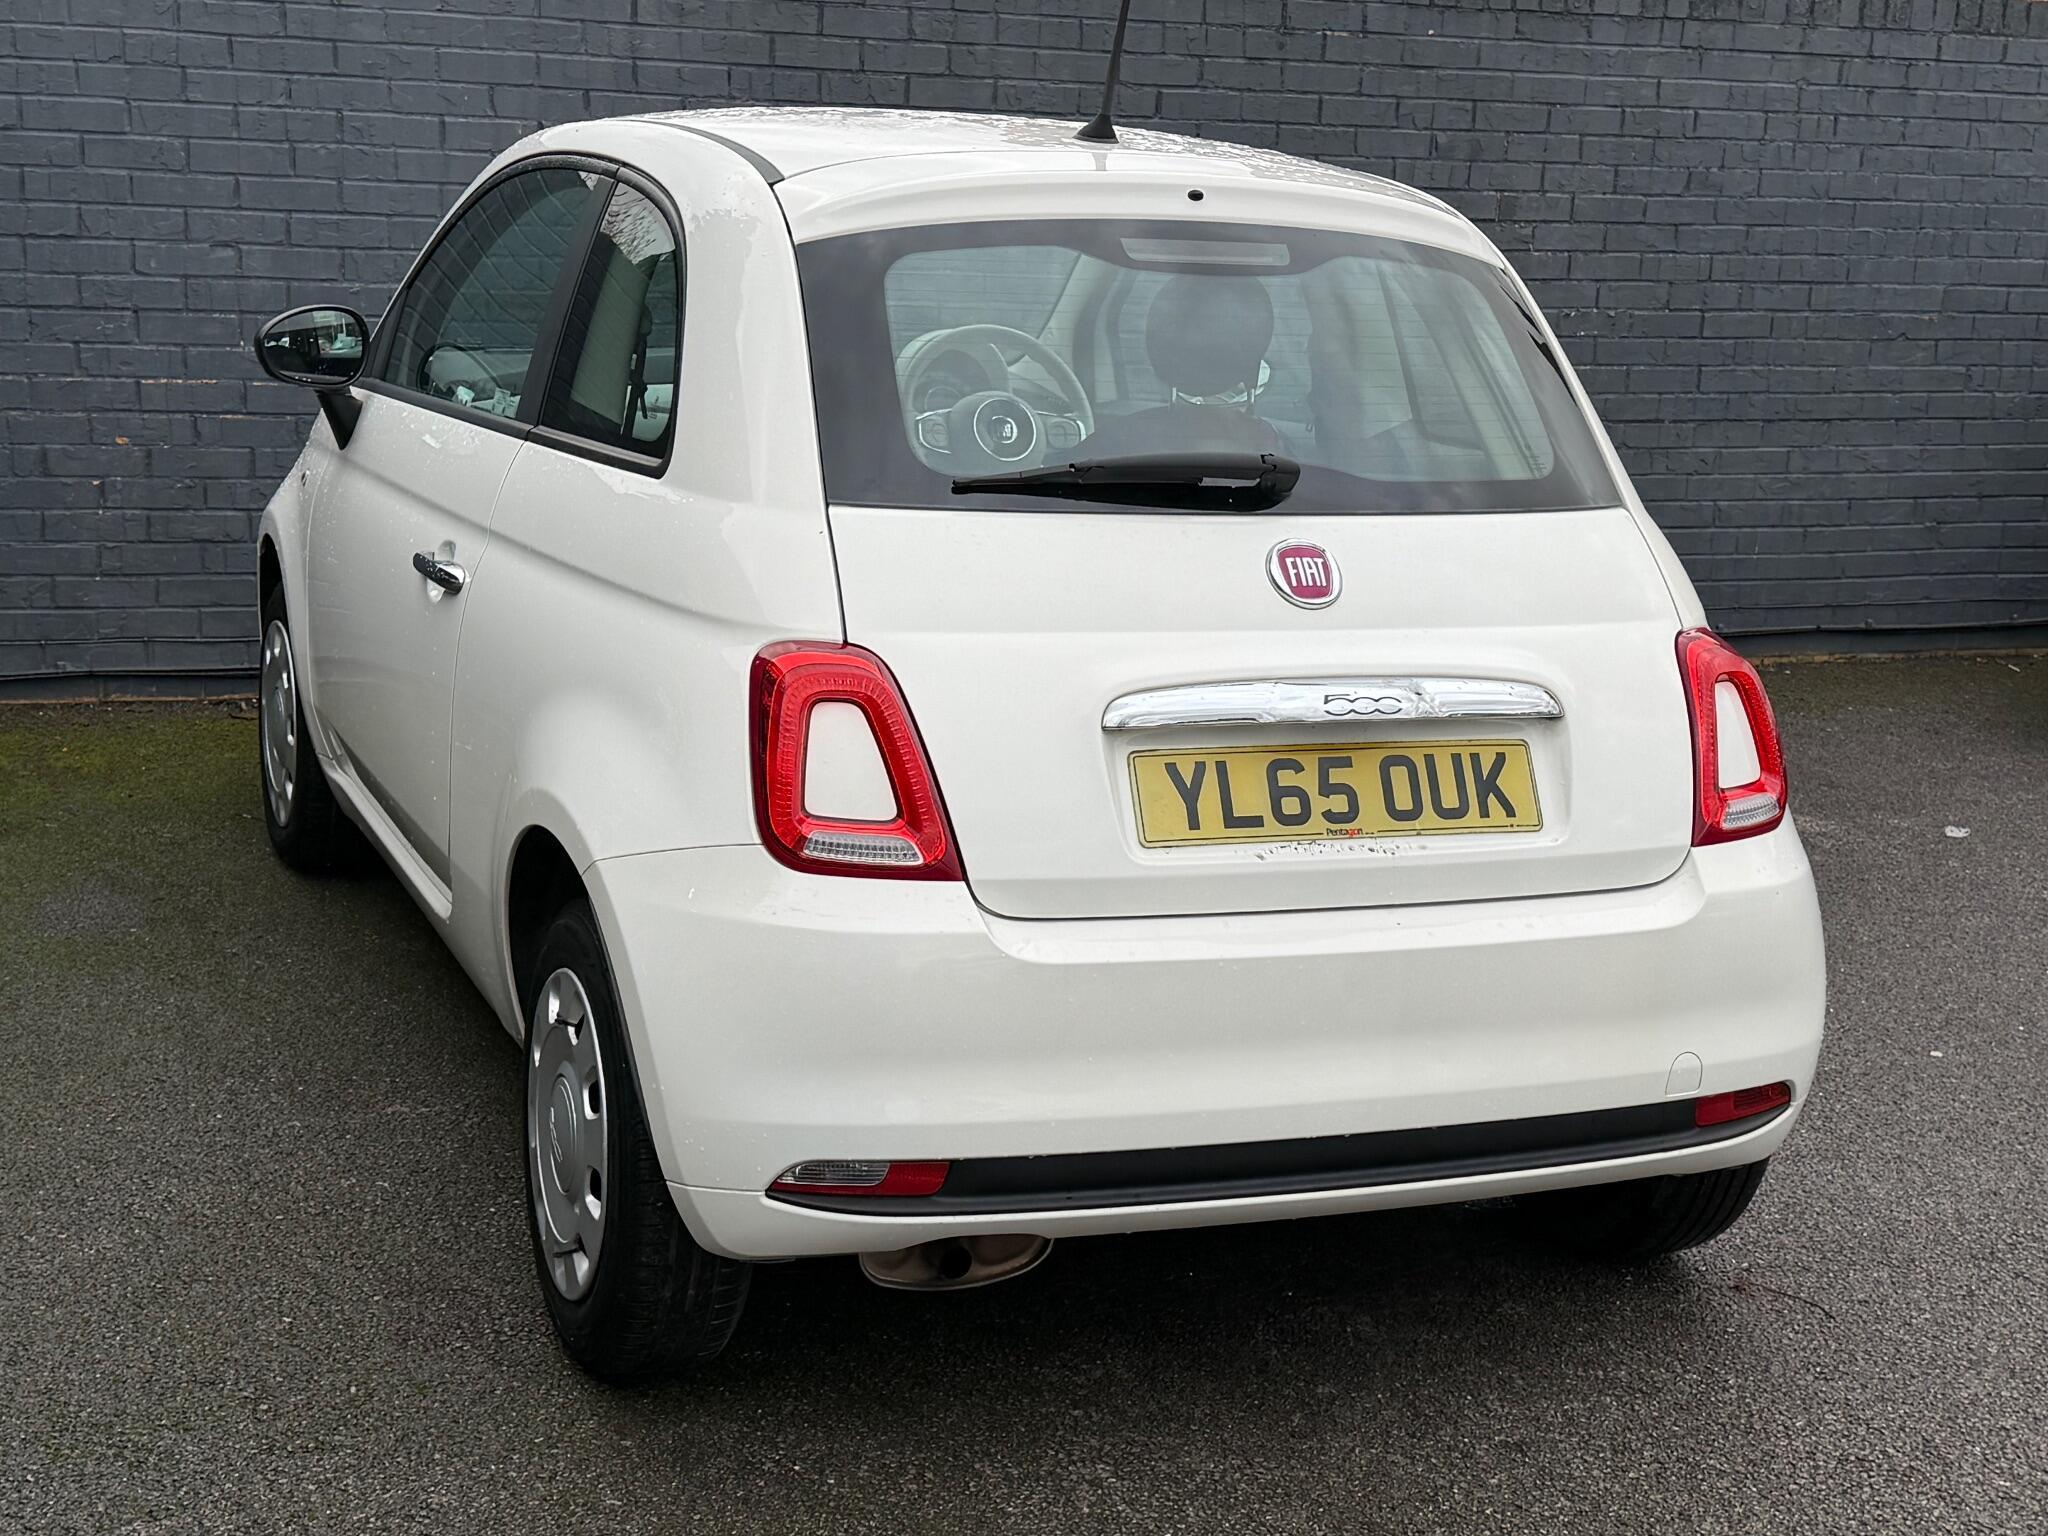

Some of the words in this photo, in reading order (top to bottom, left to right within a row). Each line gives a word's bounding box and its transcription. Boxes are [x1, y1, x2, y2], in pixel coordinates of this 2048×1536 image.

[1284, 556, 1327, 588] FIAT
[1323, 693, 1403, 717] 500
[1164, 754, 1362, 831] YL65
[1378, 751, 1517, 823] OUK
[1326, 828, 1364, 838] Pentagon
